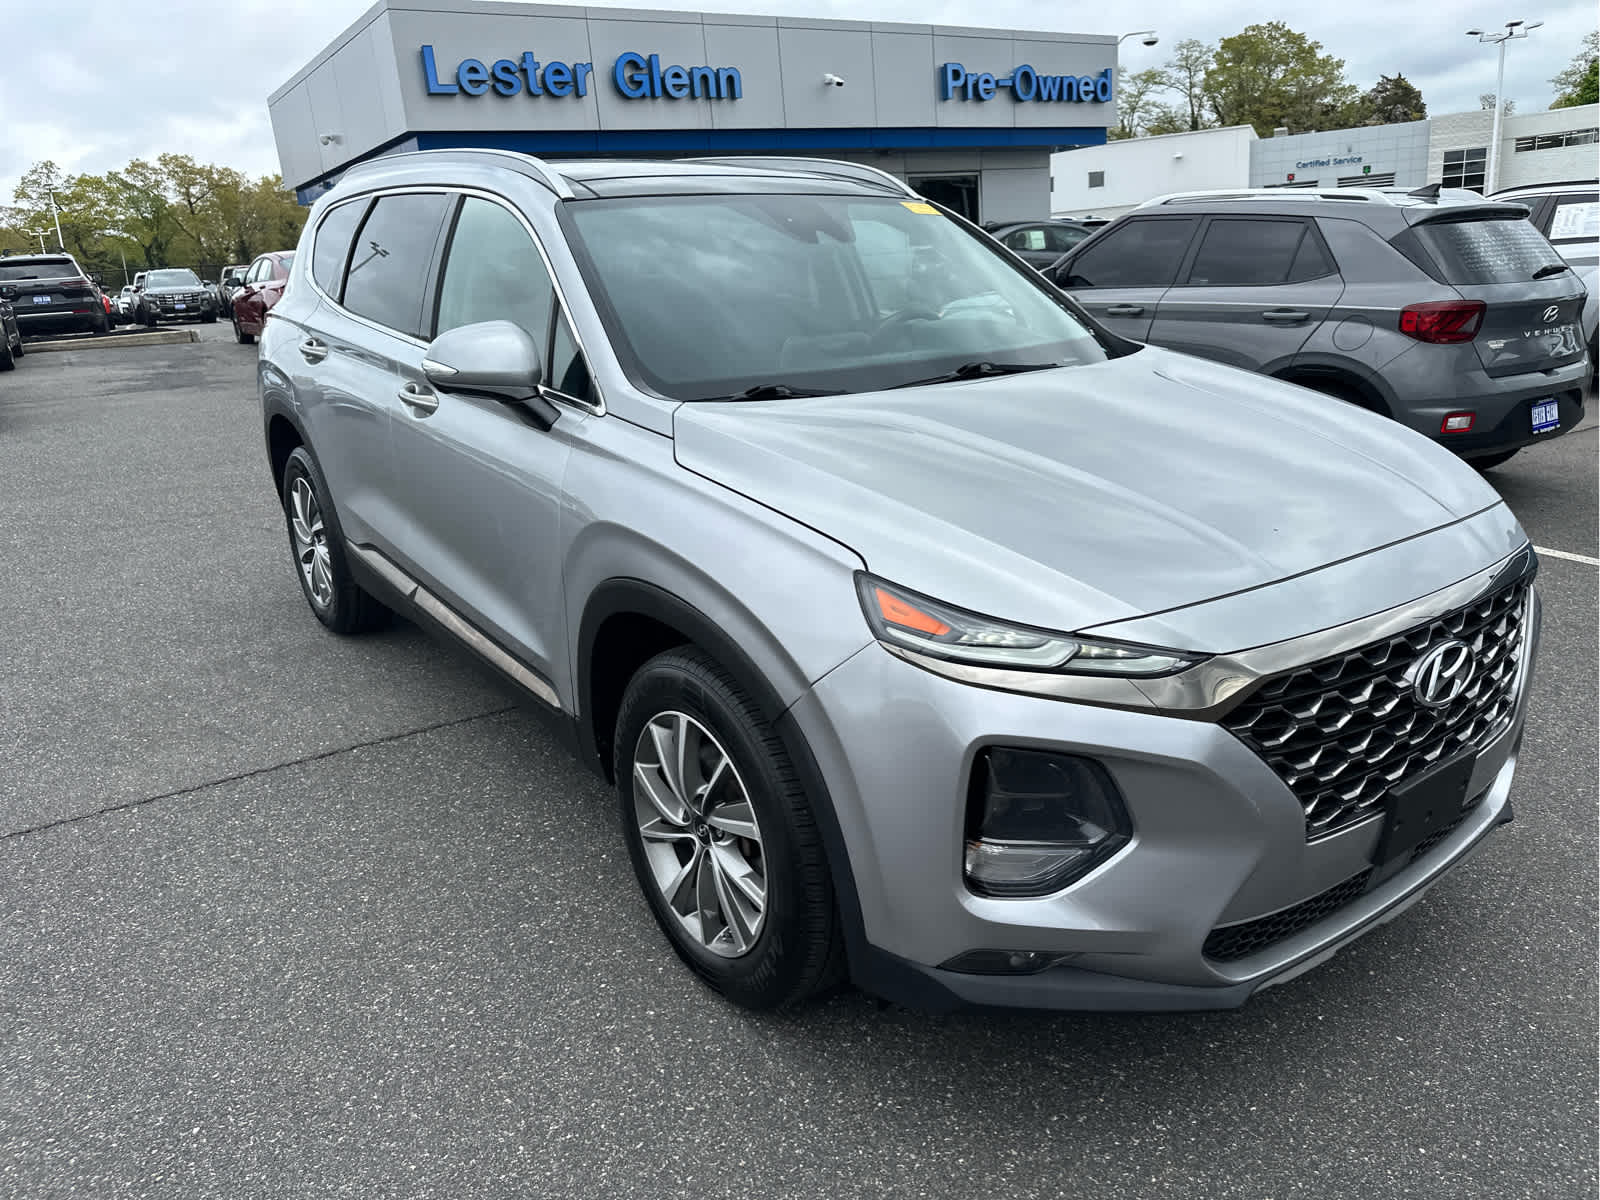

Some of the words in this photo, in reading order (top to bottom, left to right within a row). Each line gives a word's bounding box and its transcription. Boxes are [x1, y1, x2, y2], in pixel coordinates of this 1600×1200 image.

[421, 45, 593, 97] Lester
[612, 51, 743, 100] Glenn
[943, 62, 1113, 102] Pre-Owned
[1296, 159, 1330, 168] Certified
[1333, 156, 1363, 165] Service
